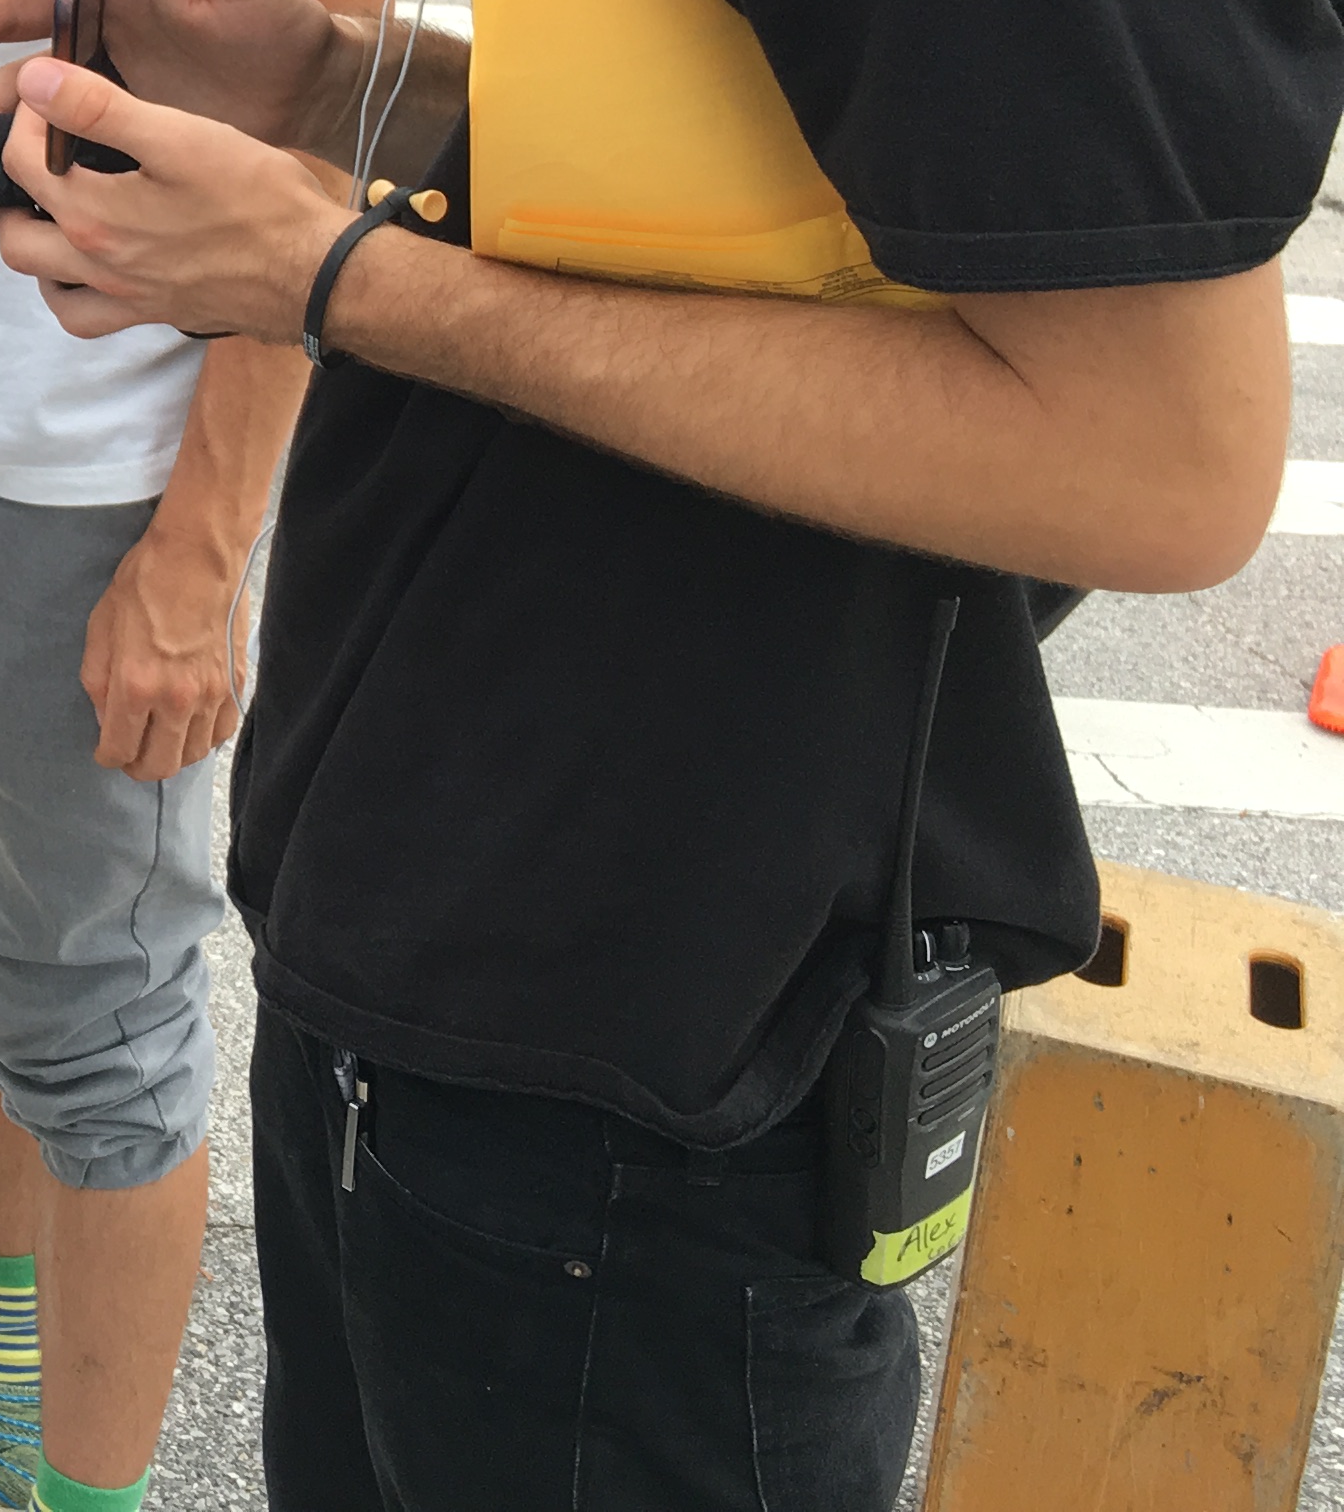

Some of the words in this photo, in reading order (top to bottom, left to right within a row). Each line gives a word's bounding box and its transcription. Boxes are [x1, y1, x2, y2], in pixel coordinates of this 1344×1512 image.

[941, 996, 996, 1039] MOTOROLA
[928, 1139, 962, 1171] 5357
[896, 1213, 957, 1263] Alex
